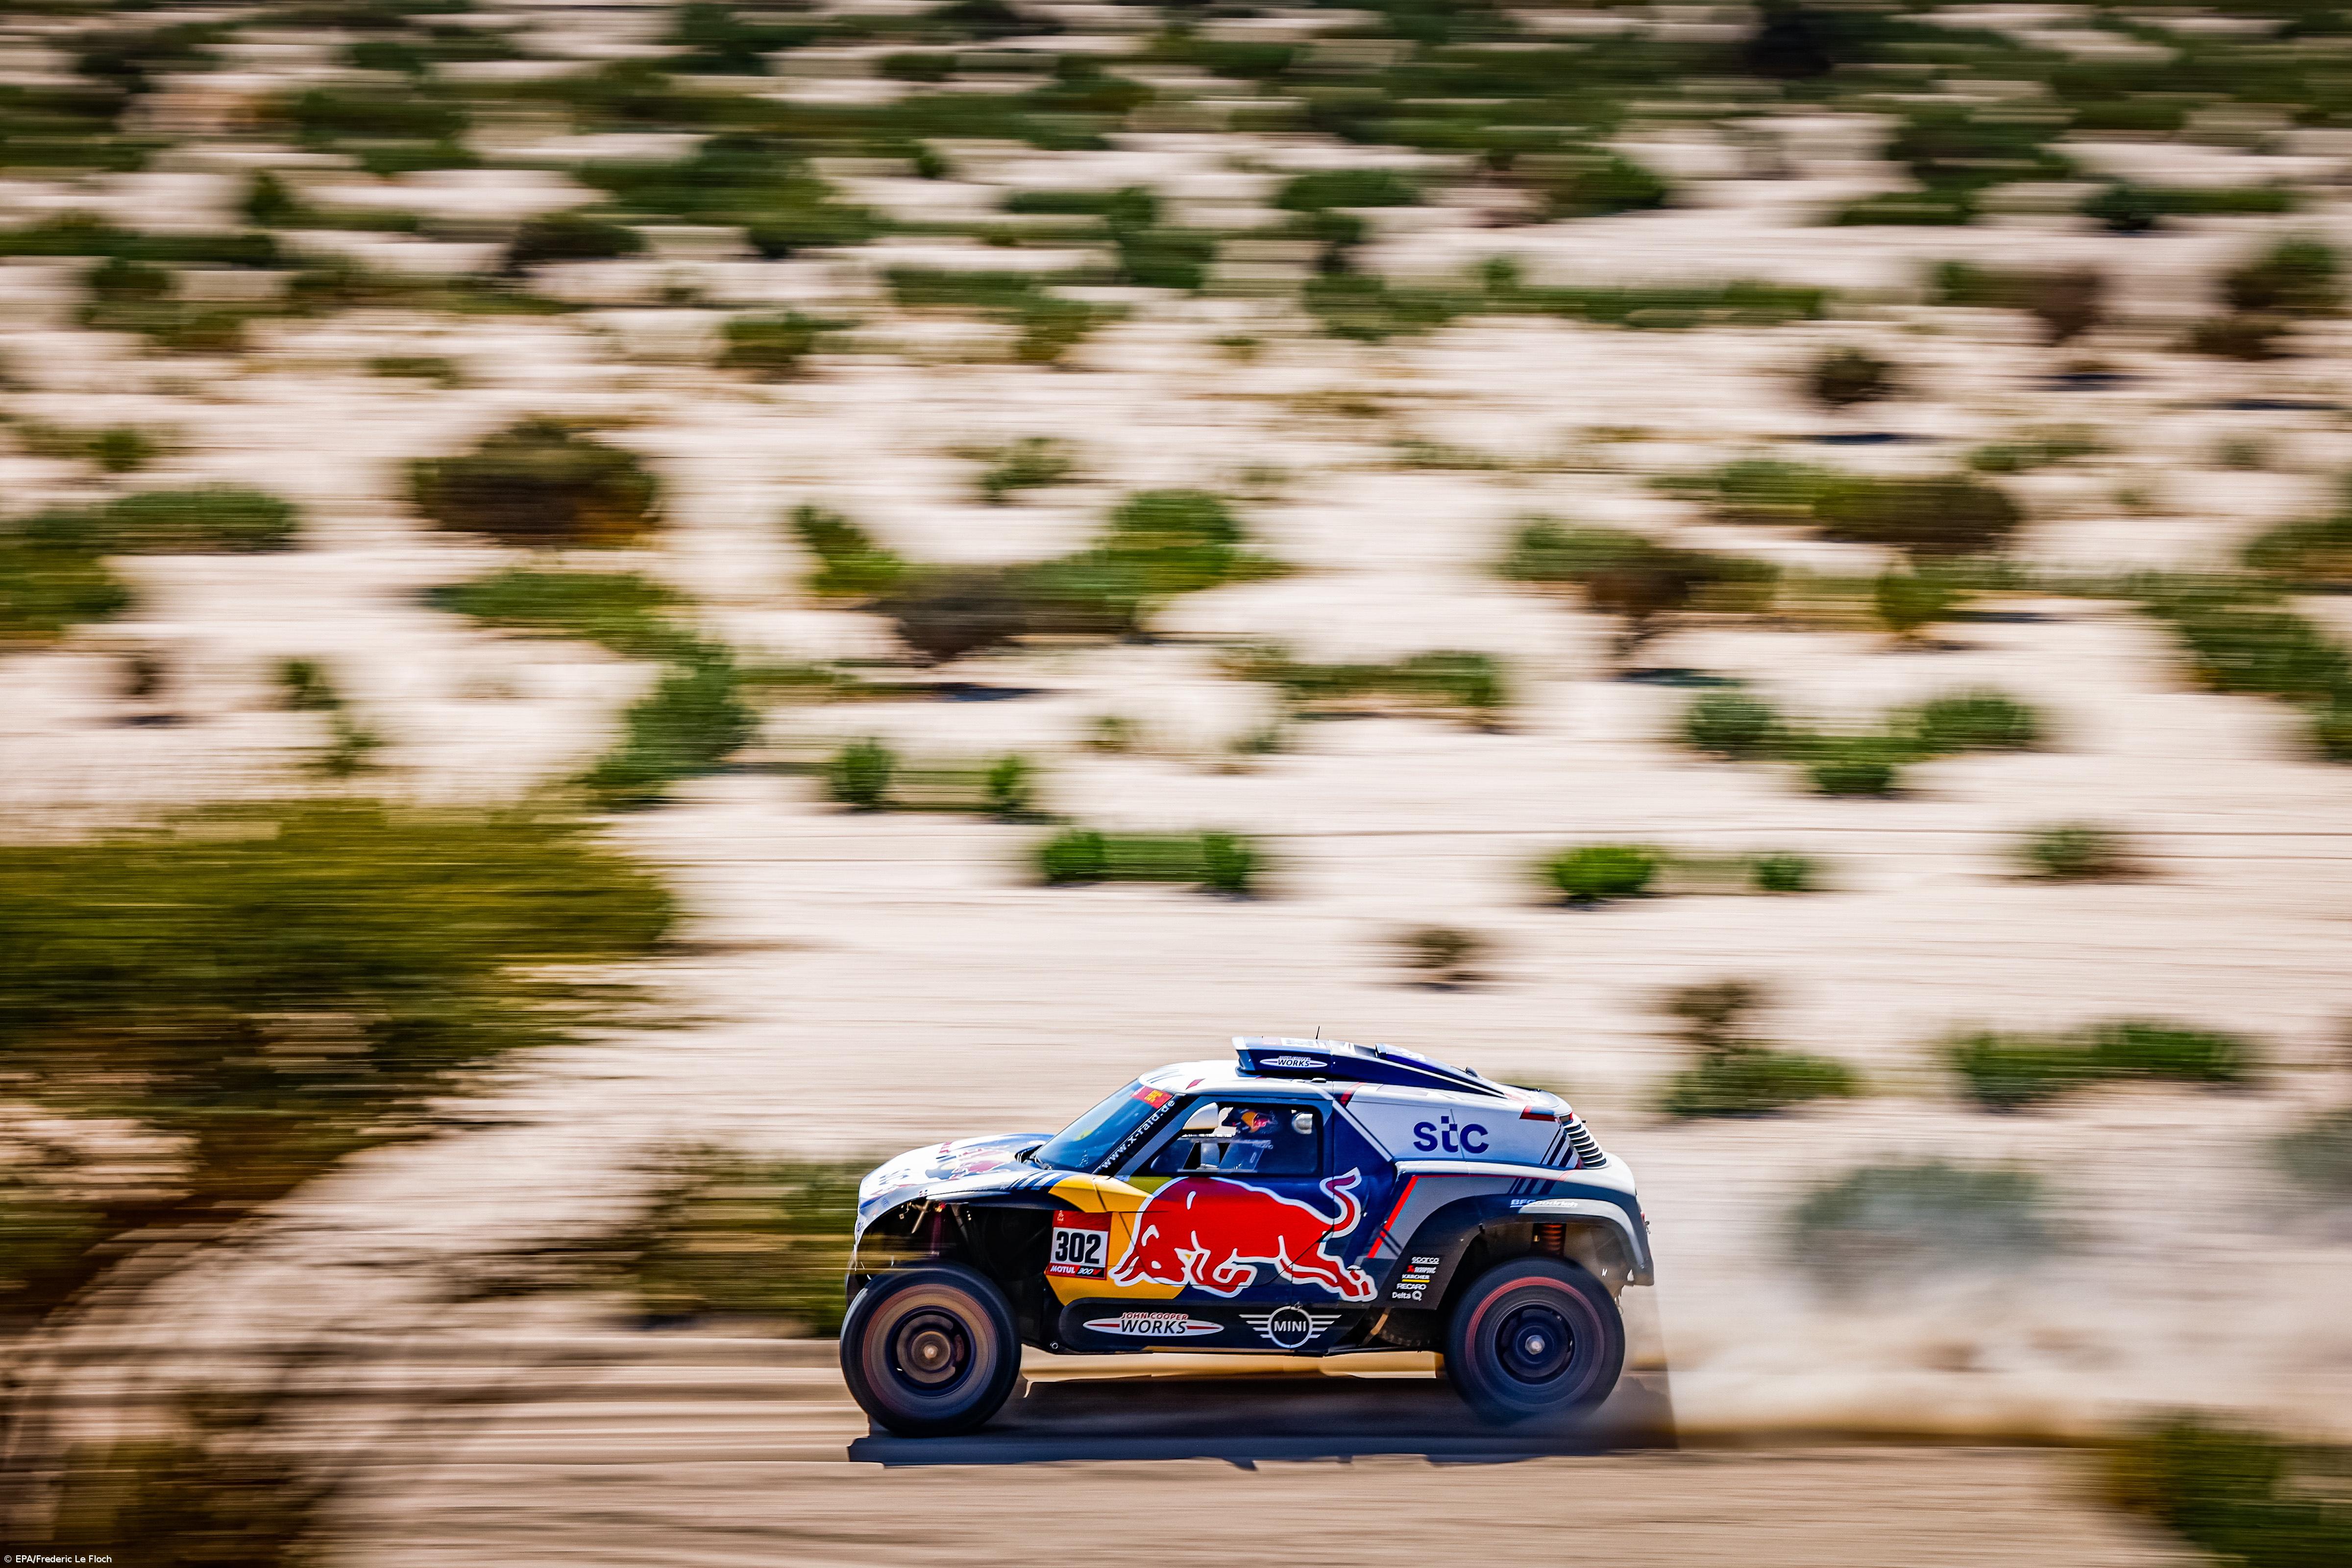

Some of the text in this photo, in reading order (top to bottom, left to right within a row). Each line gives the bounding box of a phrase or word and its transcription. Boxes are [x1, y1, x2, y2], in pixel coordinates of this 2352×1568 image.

[1102, 1100, 1175, 1169] www.x-raid.de
[1413, 1116, 1489, 1153] stc
[1055, 1231, 1101, 1264] 302
[1050, 1265, 1076, 1274] MOTUL
[1121, 1320, 1187, 1334] WORKS
[1274, 1321, 1306, 1332] MINI
